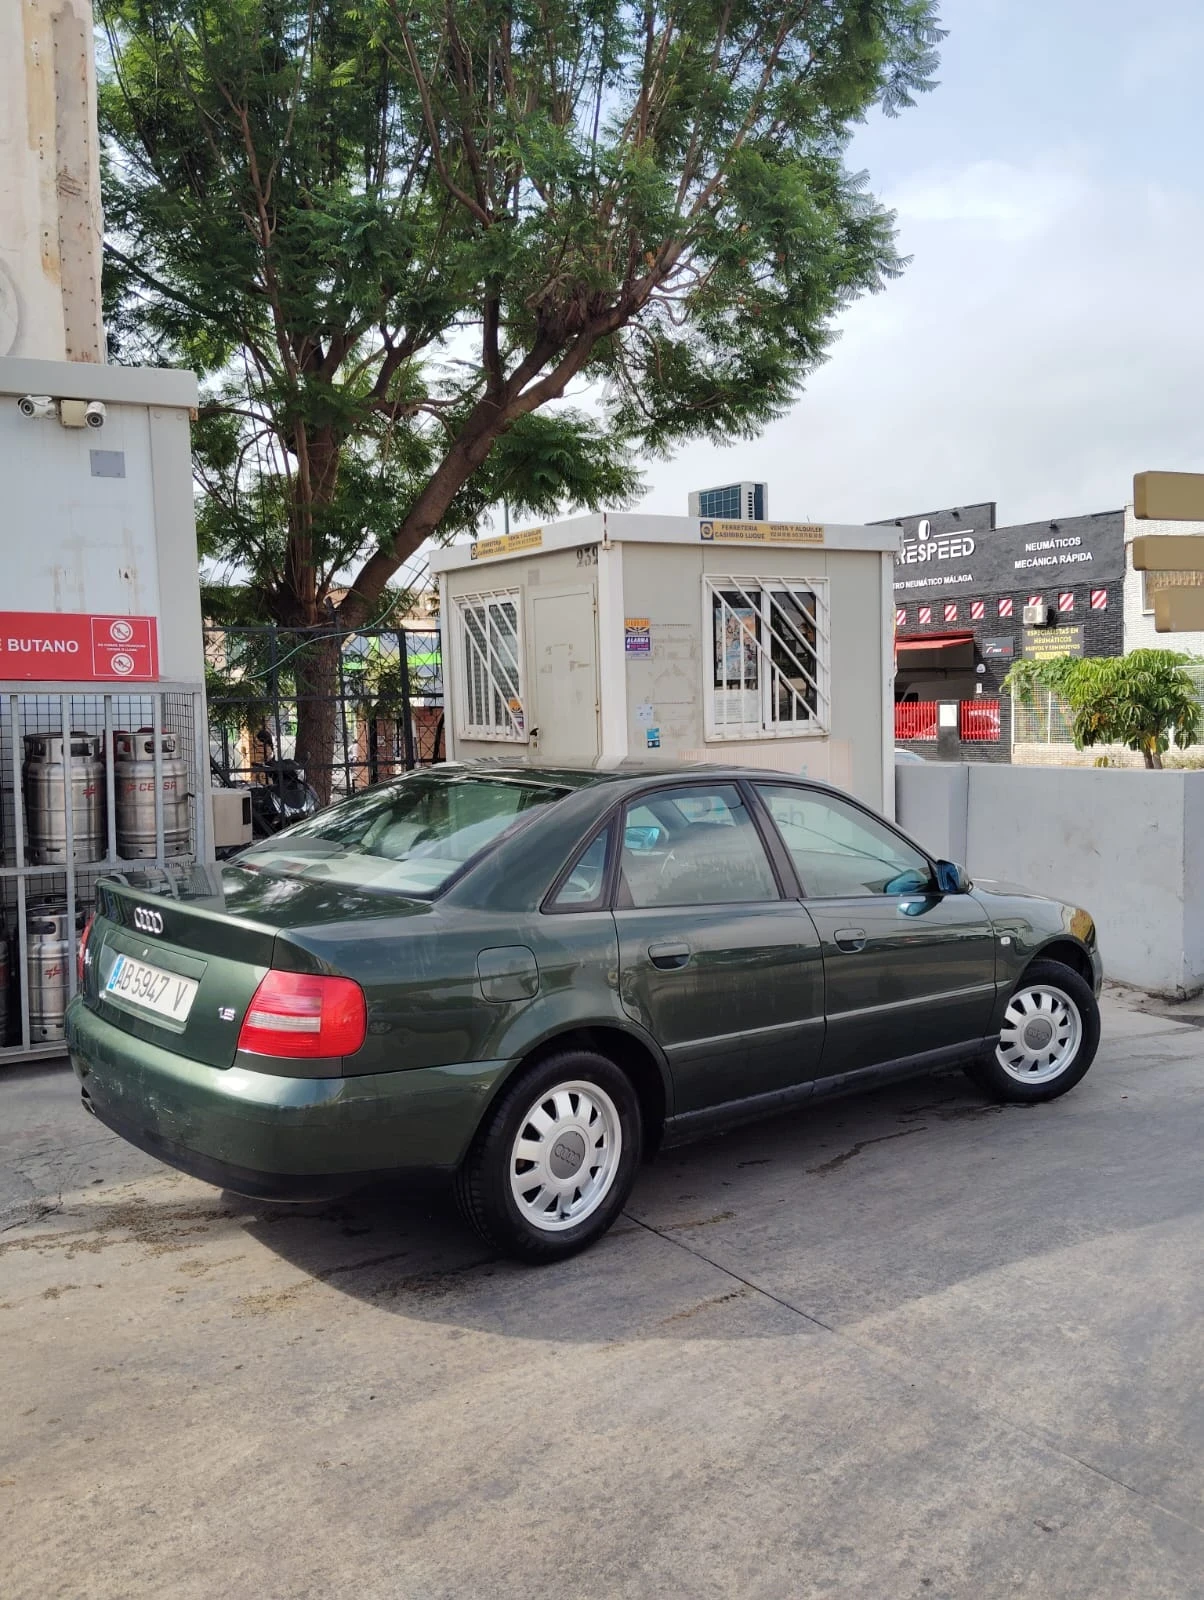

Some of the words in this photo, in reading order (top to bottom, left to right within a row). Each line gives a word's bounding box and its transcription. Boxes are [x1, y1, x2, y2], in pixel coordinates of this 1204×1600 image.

[721, 524, 758, 532] FERRETERIA
[795, 525, 823, 533] ALQUILER
[1025, 536, 1081, 552] NEUMÁTICOS
[1014, 556, 1058, 569] MECÁNICA
[1059, 551, 1093, 564] RÁPIDA
[905, 577, 942, 588] NEUMÁTICO
[943, 573, 973, 584] MÁLAGA
[1027, 627, 1069, 637] ESPECIALISTAS
[7, 638, 79, 653] BUTANO
[1033, 636, 1072, 644] NEUMÁTICOS
